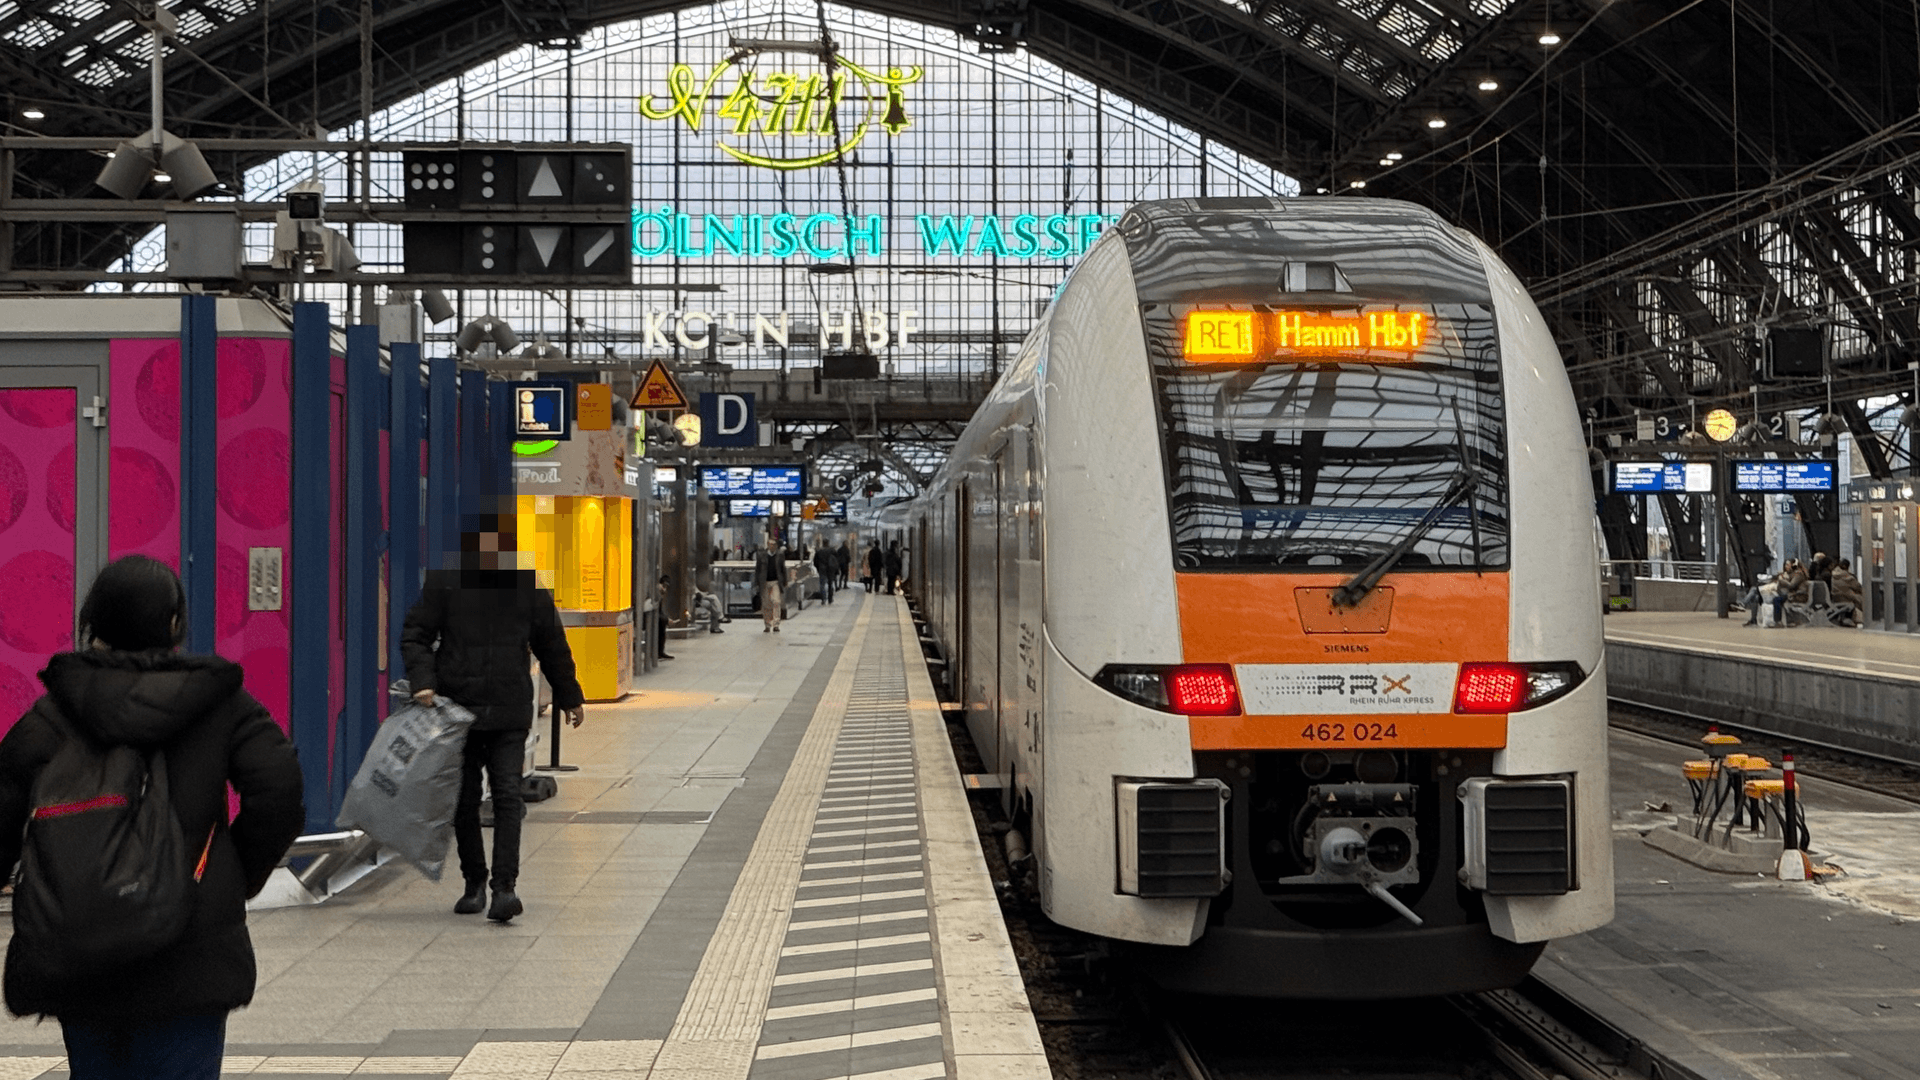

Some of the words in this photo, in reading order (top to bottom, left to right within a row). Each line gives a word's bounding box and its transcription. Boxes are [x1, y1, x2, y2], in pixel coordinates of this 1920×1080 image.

[717, 71, 847, 136] 4711
[631, 204, 882, 258] ÖLNISCH
[916, 213, 1119, 258] WASSE
[820, 310, 919, 350] HBF
[1199, 319, 1243, 350] RE1
[1279, 313, 1360, 348] Hamm
[1369, 312, 1421, 347] Hbf
[717, 394, 748, 435] D
[1656, 416, 1670, 436] 3
[1770, 416, 1783, 436] 2
[835, 475, 847, 491] C
[1323, 644, 1370, 654] SIEMENS
[1316, 674, 1412, 696] RRX
[1350, 697, 1376, 705] RHEIN
[1378, 697, 1401, 705] RUHR
[1301, 723, 1345, 741] 462
[1353, 723, 1398, 741] 024
